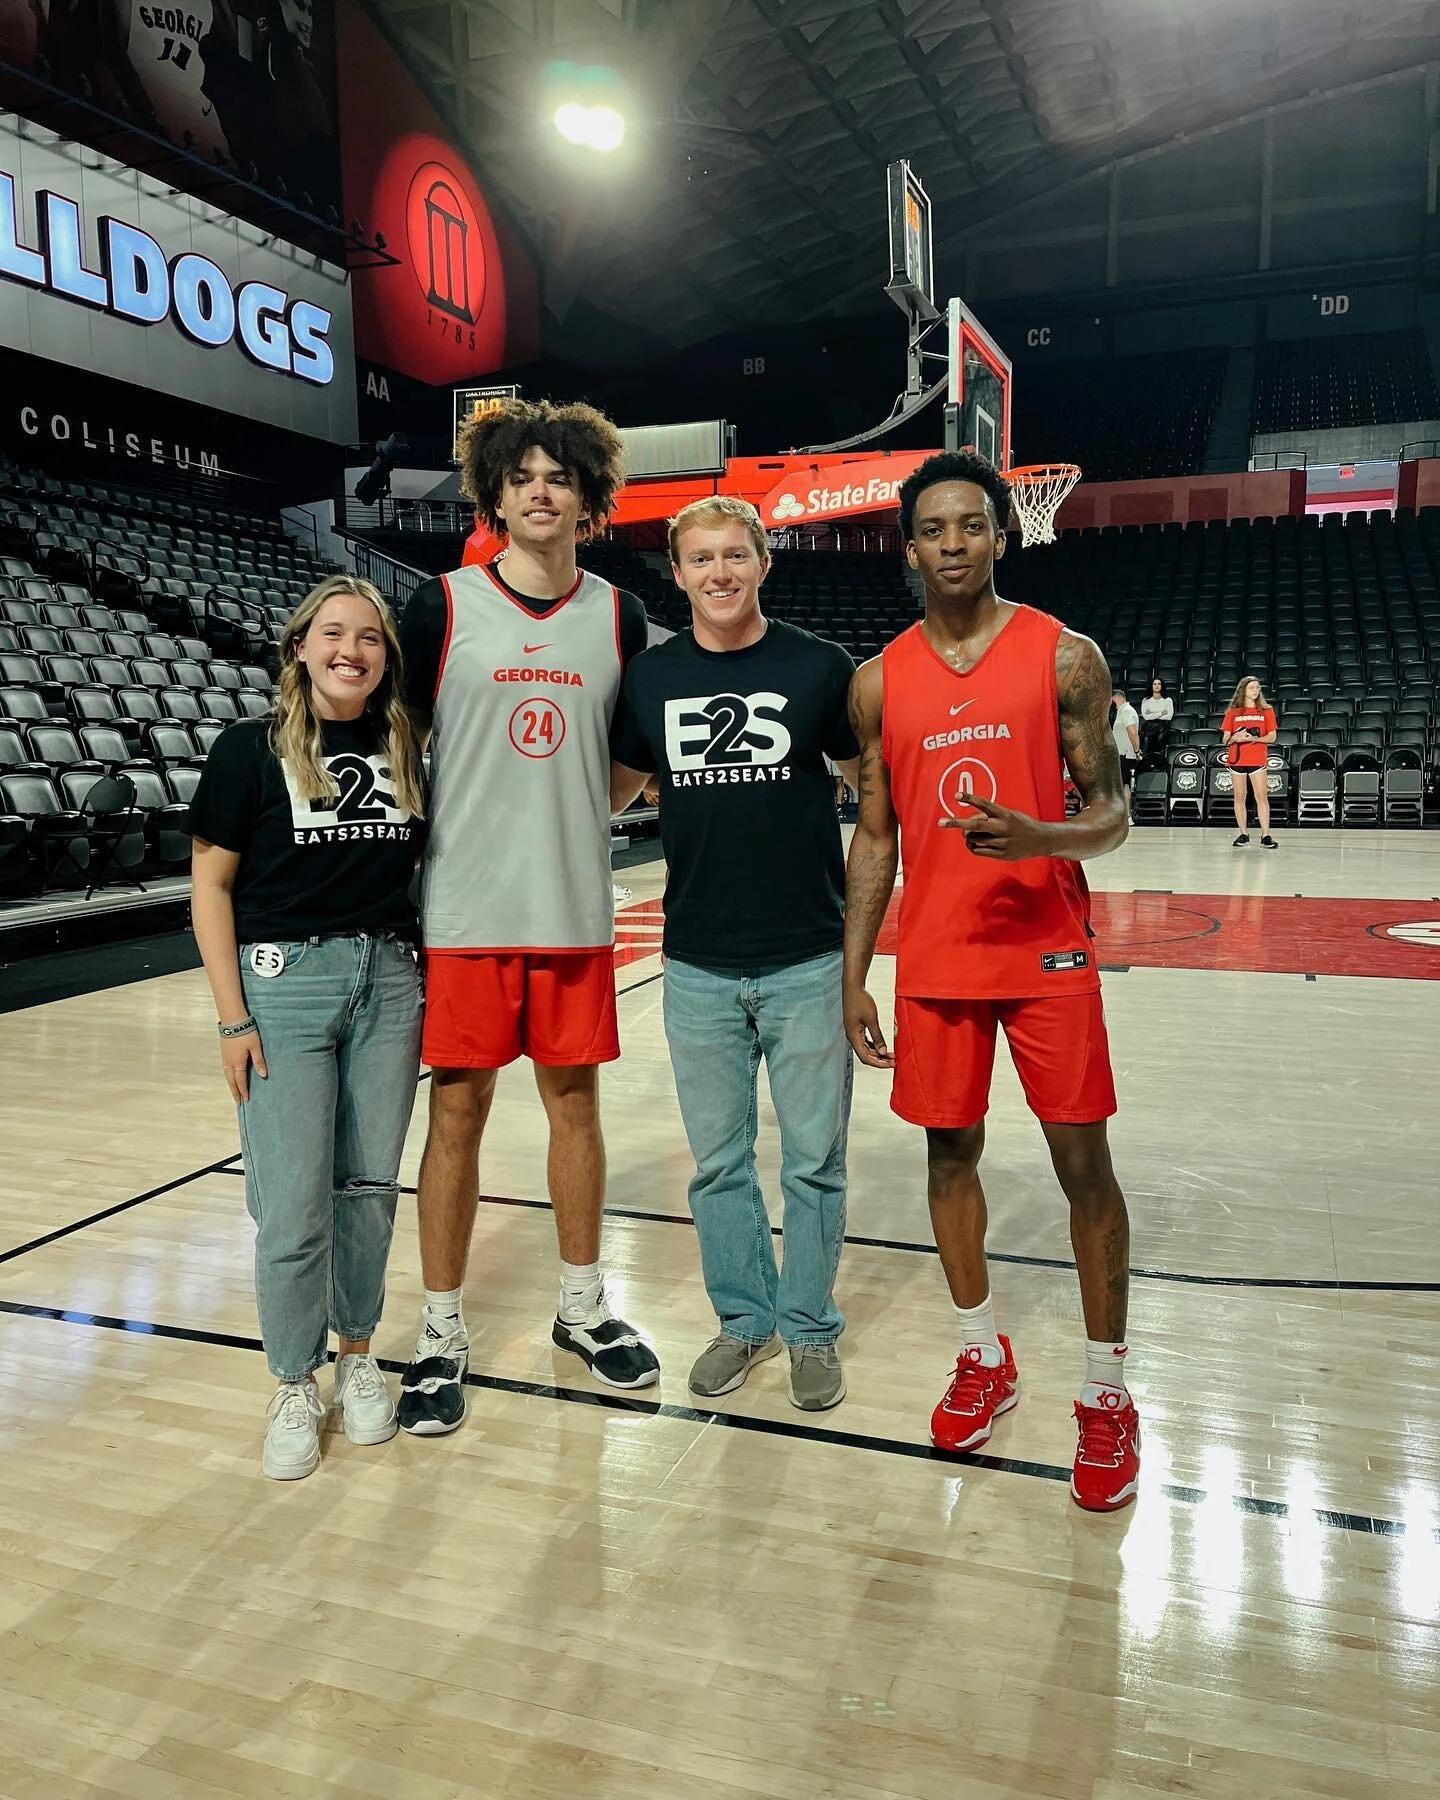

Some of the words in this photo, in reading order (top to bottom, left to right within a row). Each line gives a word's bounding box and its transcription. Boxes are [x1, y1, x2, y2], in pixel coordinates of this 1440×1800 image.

[156, 37, 192, 70] 11
[0, 170, 335, 387] LLDOGS
[1320, 295, 1350, 316] DD
[427, 309, 476, 350] 1785
[1027, 327, 1051, 347] CC
[743, 357, 766, 375] BB
[366, 371, 391, 402] AA
[20, 406, 219, 477] COLISEUM
[806, 485, 865, 514] State
[866, 477, 903, 508] Far
[493, 668, 584, 687] GEORGIA
[522, 710, 553, 745] 24
[664, 691, 792, 772] E2S
[922, 724, 1012, 751] GEORGIA
[671, 766, 791, 788] EATS2SEATS
[293, 825, 411, 845] EATS2SEATS
[1076, 954, 1084, 963] M
